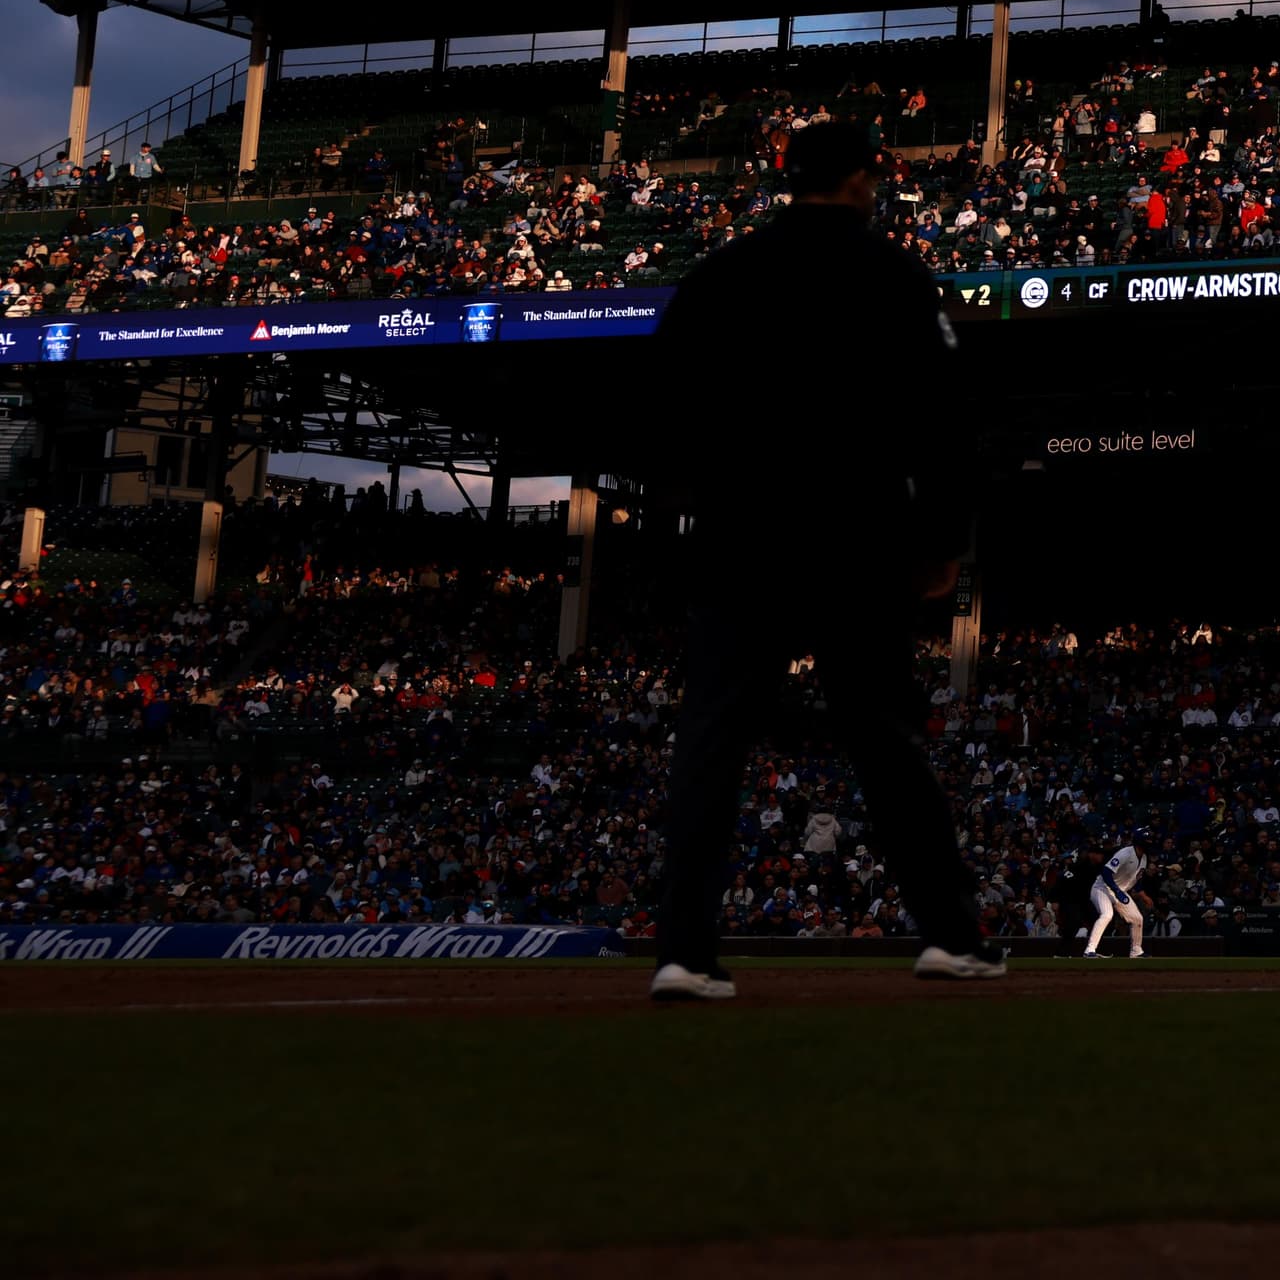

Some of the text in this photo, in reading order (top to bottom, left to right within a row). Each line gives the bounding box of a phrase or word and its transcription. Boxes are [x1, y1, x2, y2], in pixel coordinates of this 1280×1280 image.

[977, 284, 991, 306] 2
[1060, 282, 1072, 302] 4
[1088, 282, 1110, 299] CF
[378, 313, 435, 328] REGAL
[523, 306, 655, 322] The Standard for Excellence
[99, 326, 223, 341] The Standard for Excellence
[271, 323, 349, 339] Benjamin Moore
[386, 327, 426, 337] SELECT
[1048, 428, 1195, 453] eero suite level
[15, 928, 112, 960] Wrap
[221, 926, 504, 960] Reynolds Wrap
